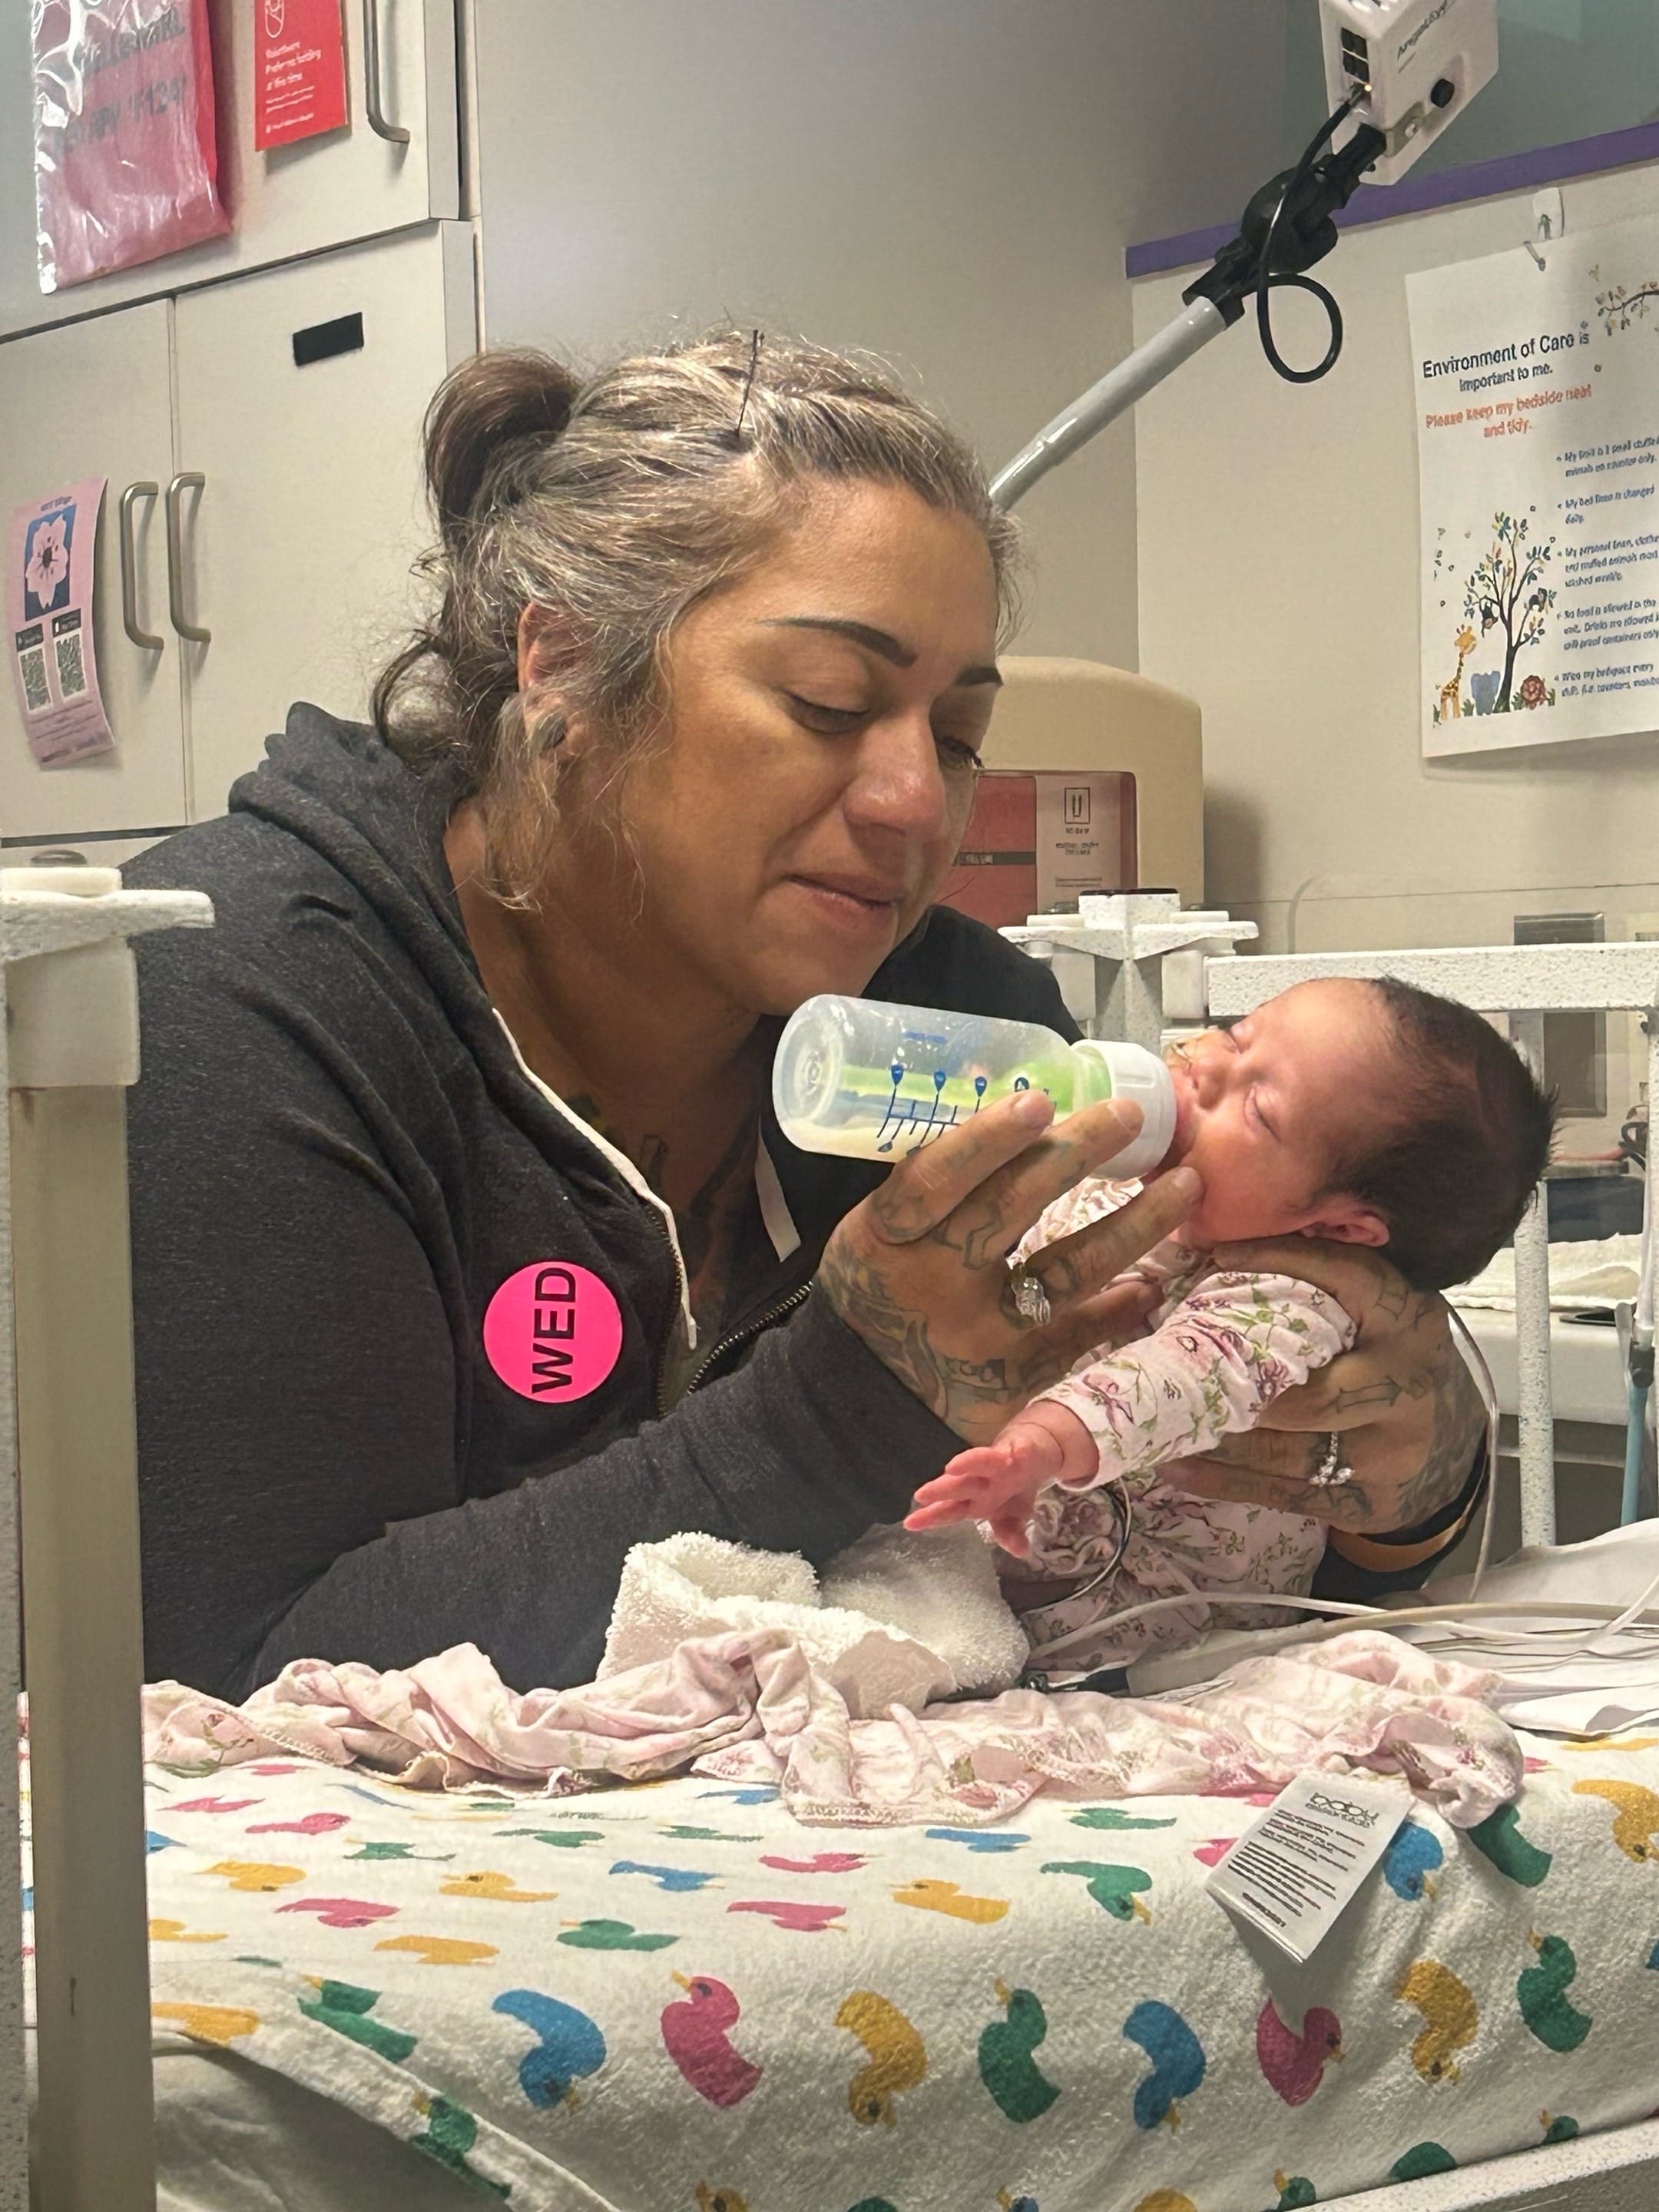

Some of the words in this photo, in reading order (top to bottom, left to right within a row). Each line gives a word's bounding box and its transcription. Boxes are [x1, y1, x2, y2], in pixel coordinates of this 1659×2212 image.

[1423, 344, 1518, 378] Environment
[1521, 338, 1535, 358] of
[1540, 333, 1575, 353] Care
[1579, 331, 1590, 345] is
[531, 1267, 576, 1394] WED
